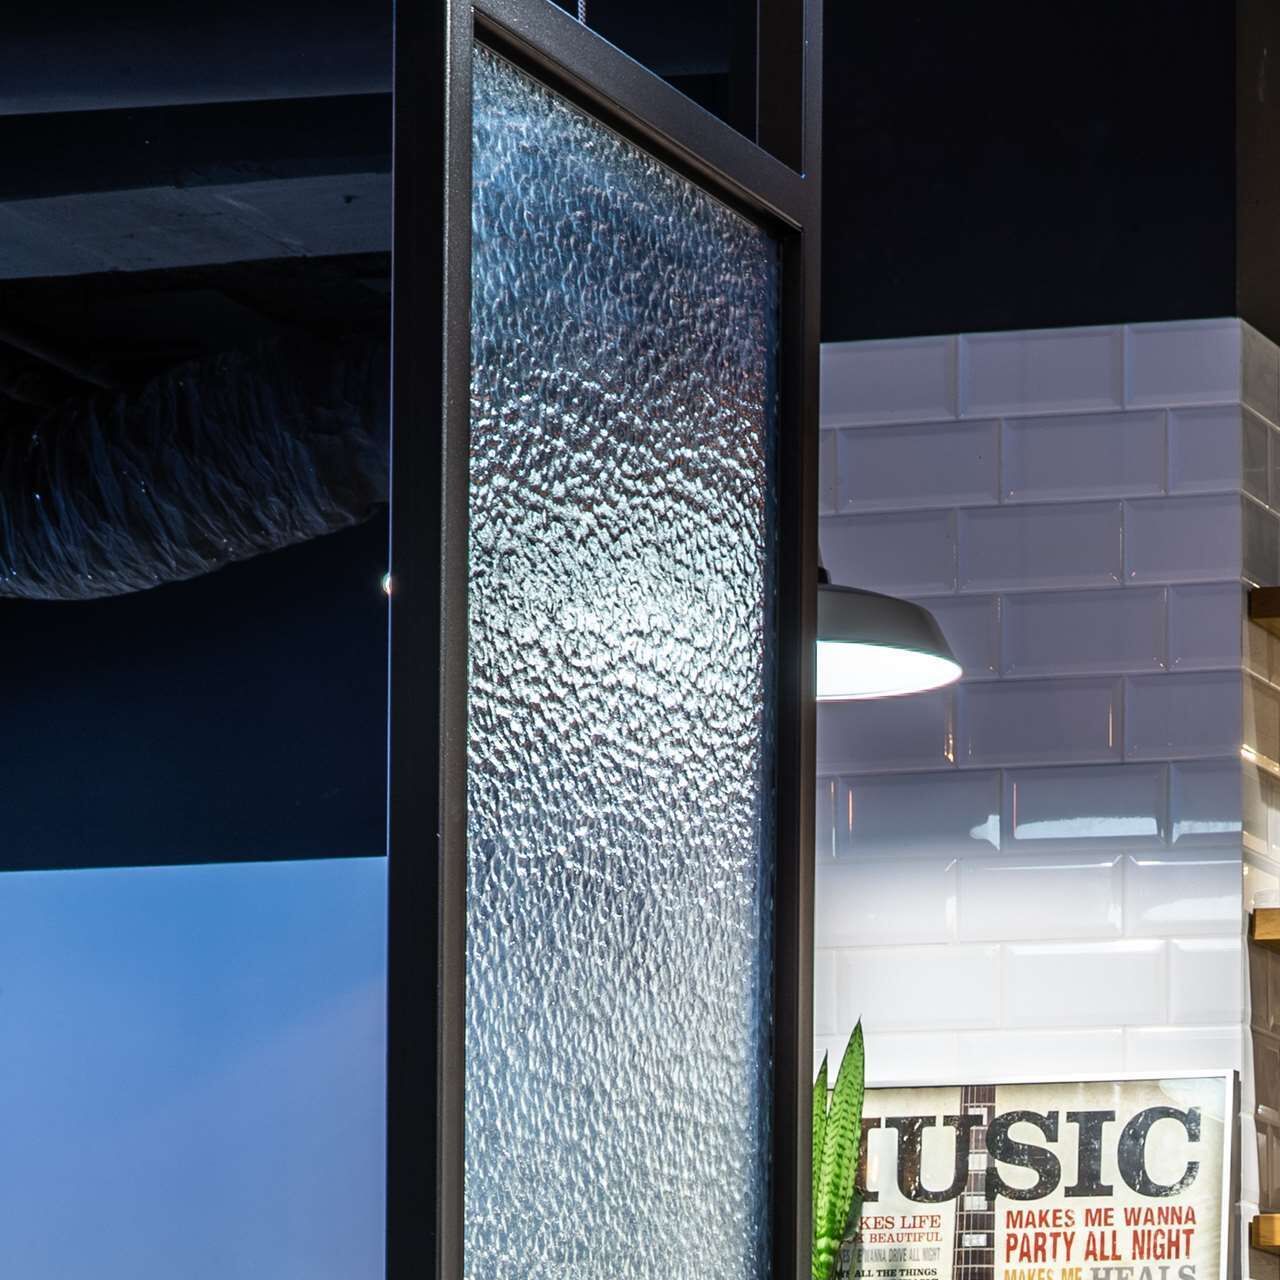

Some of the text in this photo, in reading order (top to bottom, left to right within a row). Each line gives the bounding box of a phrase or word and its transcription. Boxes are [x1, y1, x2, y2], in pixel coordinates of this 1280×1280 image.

[859, 1215, 941, 1230] KES LIFE
[1006, 1206, 1196, 1229] MAKES ME WANNA
[870, 1232, 943, 1243] BEAUTIFUL
[1006, 1228, 1195, 1263] PARTY ALL NIGHT
[855, 1269, 874, 1278] ALL
[877, 1269, 897, 1277] THE
[898, 1268, 938, 1277] THINGS
